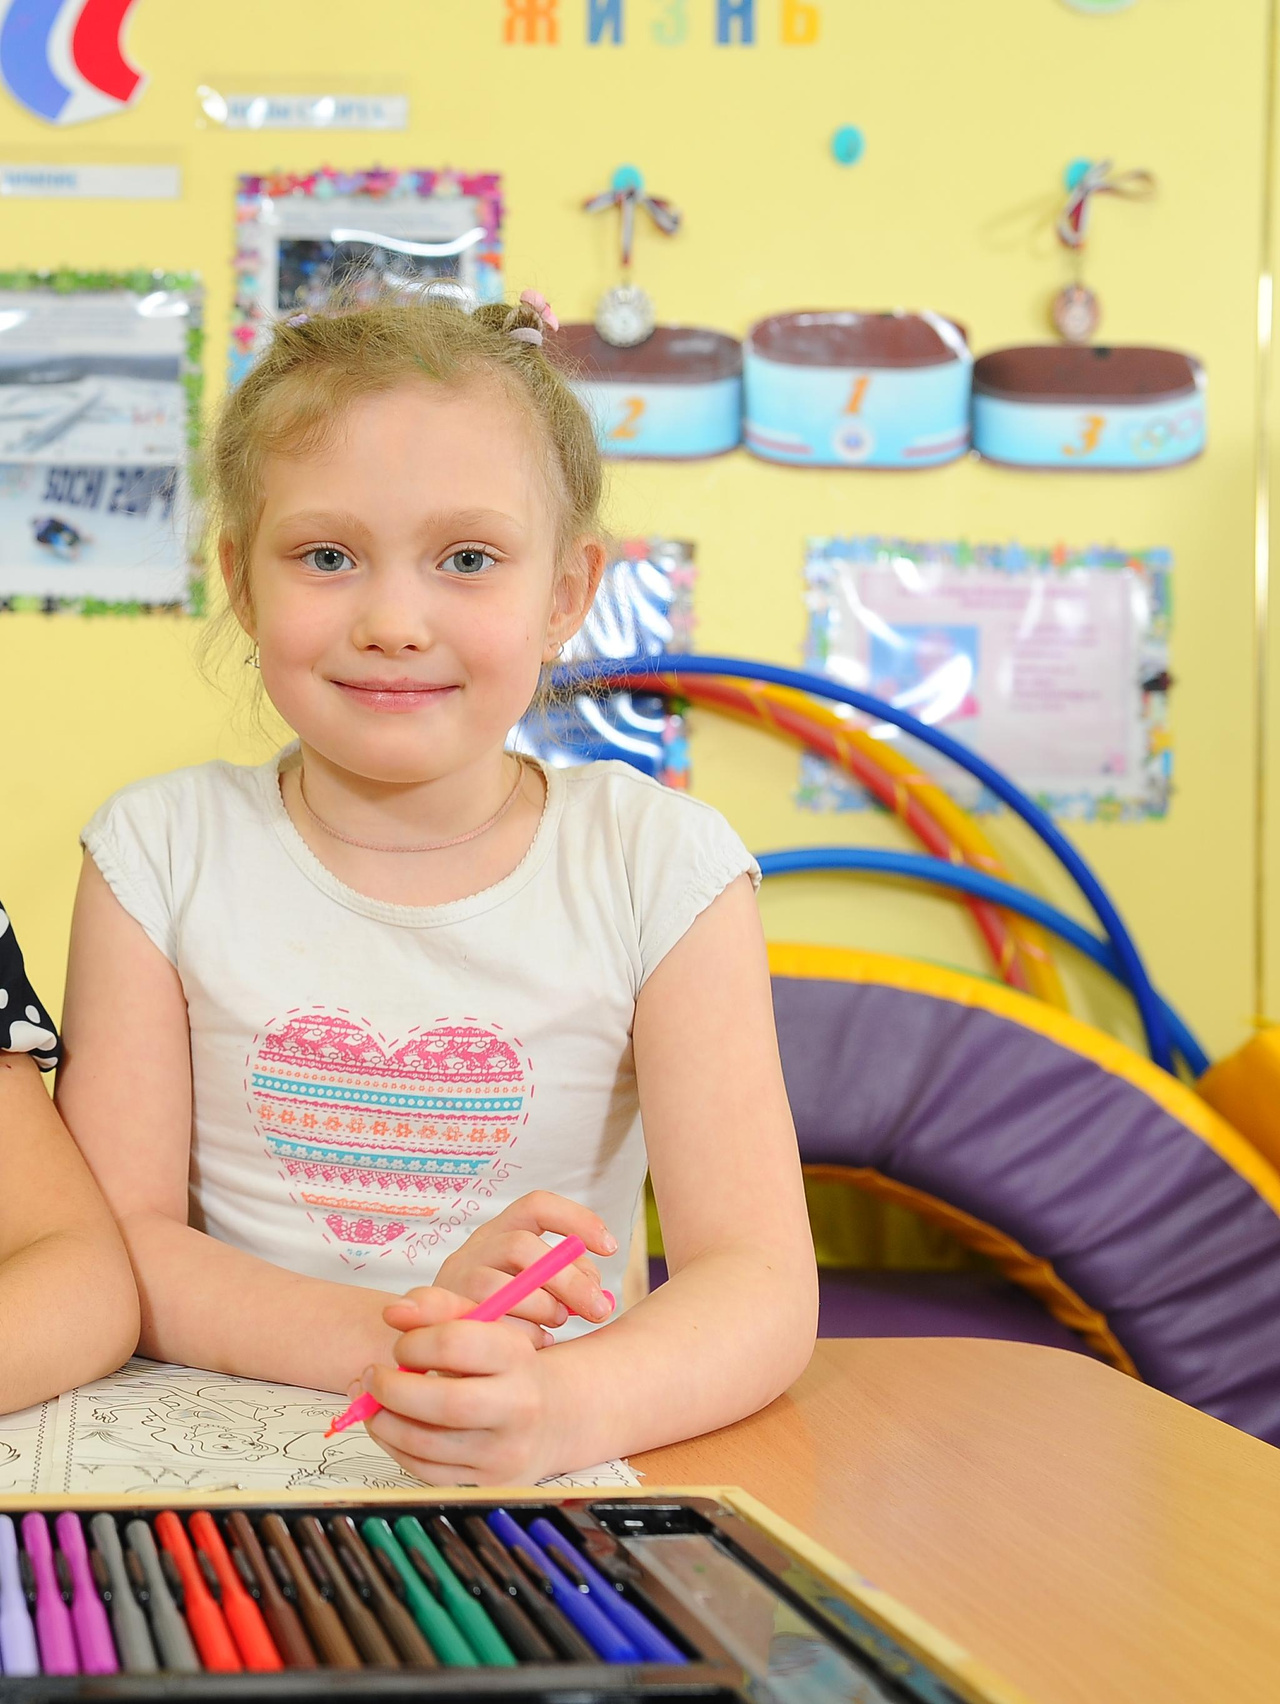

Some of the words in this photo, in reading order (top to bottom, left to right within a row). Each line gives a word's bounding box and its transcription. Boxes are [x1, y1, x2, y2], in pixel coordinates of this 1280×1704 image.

[843, 374, 870, 416] 1
[609, 397, 645, 438] 2
[1061, 413, 1106, 457] 3
[402, 1199, 480, 1266] crockid
